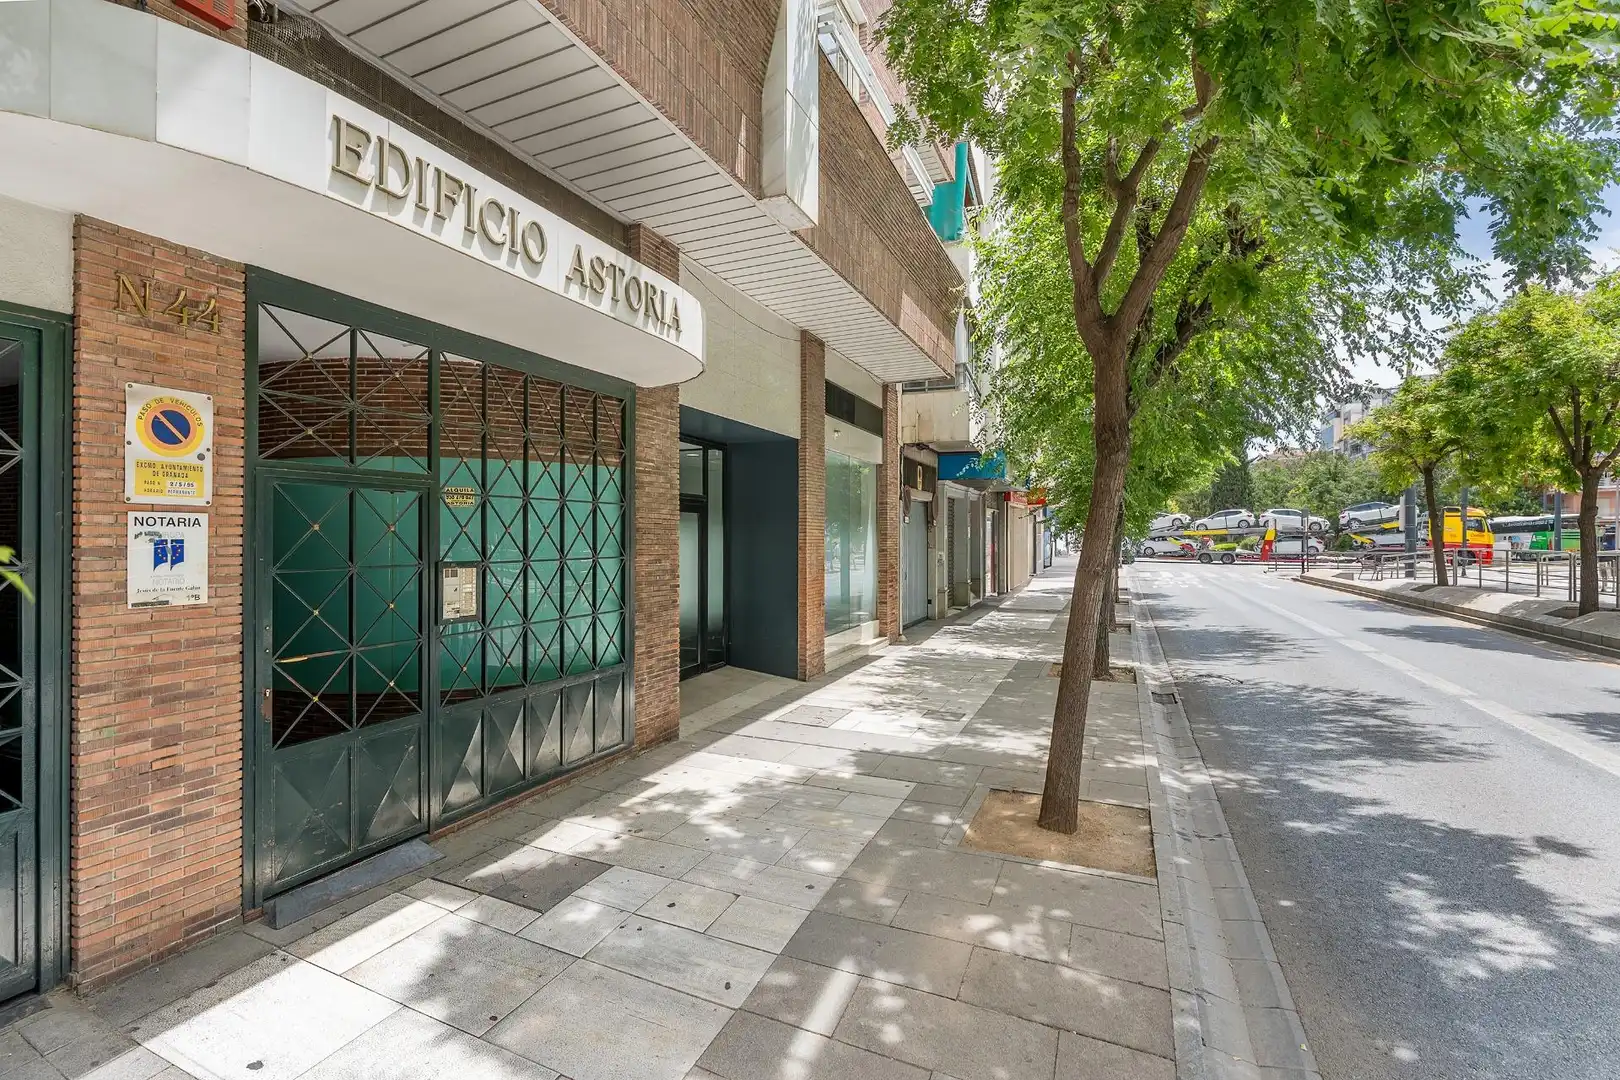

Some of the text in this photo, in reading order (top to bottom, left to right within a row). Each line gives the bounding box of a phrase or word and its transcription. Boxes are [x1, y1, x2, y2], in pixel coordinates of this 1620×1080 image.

[331, 114, 684, 335] EDIFICIO ASTORIA
[162, 289, 223, 334] 44
[137, 402, 152, 420] PASO
[169, 397, 204, 427] VEHICULOS
[134, 516, 201, 527] NOTARIA
